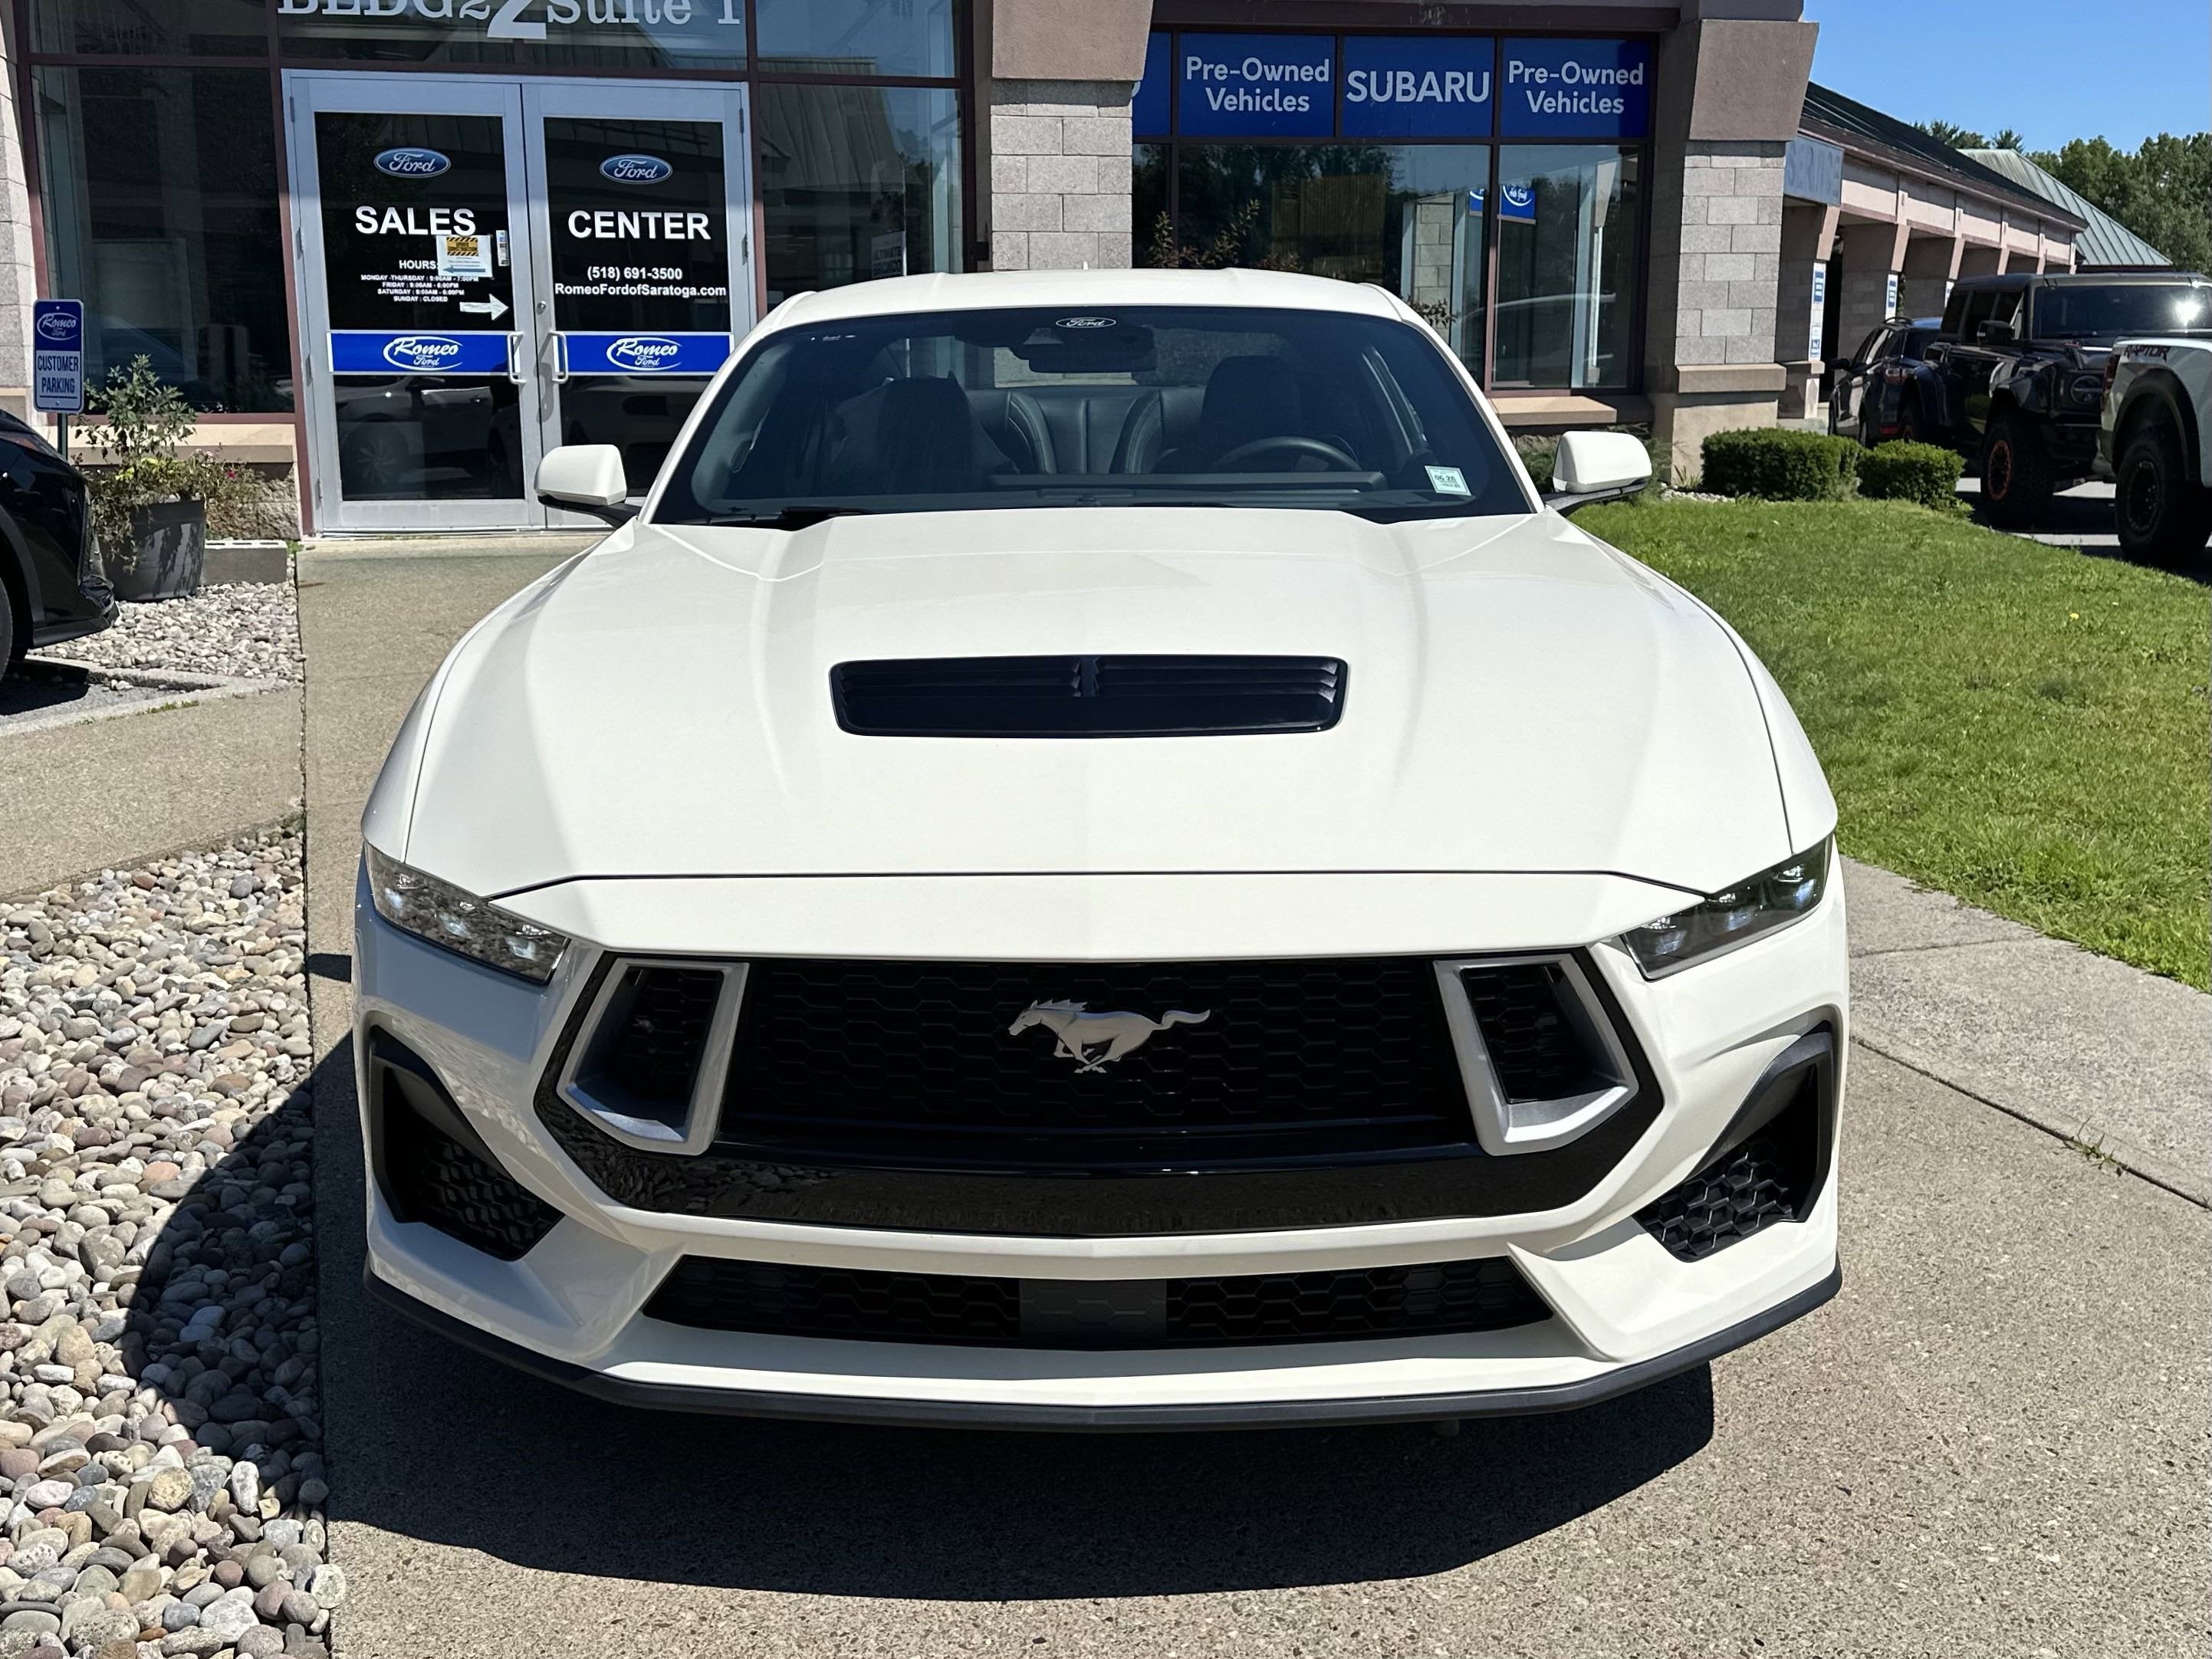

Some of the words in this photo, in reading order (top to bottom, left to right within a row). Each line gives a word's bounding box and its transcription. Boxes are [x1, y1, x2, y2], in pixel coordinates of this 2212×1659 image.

[1186, 56, 1330, 82] Pre-Owned
[1508, 61, 1643, 85] Pre-Owned
[1346, 70, 1490, 103] SUBARU
[1205, 87, 1310, 112] Vehicles
[1526, 90, 1625, 114] Vehicles
[389, 153, 435, 174] Ford
[613, 159, 658, 180] Ford
[355, 205, 476, 236] SALES
[568, 210, 712, 240] CENTER
[587, 266, 620, 281] (518)
[624, 268, 683, 281] 691-3500
[554, 283, 727, 298] RomeoFordofSaratoga.com
[42, 313, 77, 329] Romeo
[393, 337, 459, 356] Romeo
[616, 338, 679, 356] Romeo
[38, 355, 79, 372] CUSTOMER
[412, 354, 440, 366] Ford
[634, 355, 660, 366] Ford
[41, 376, 75, 394] PARKING
